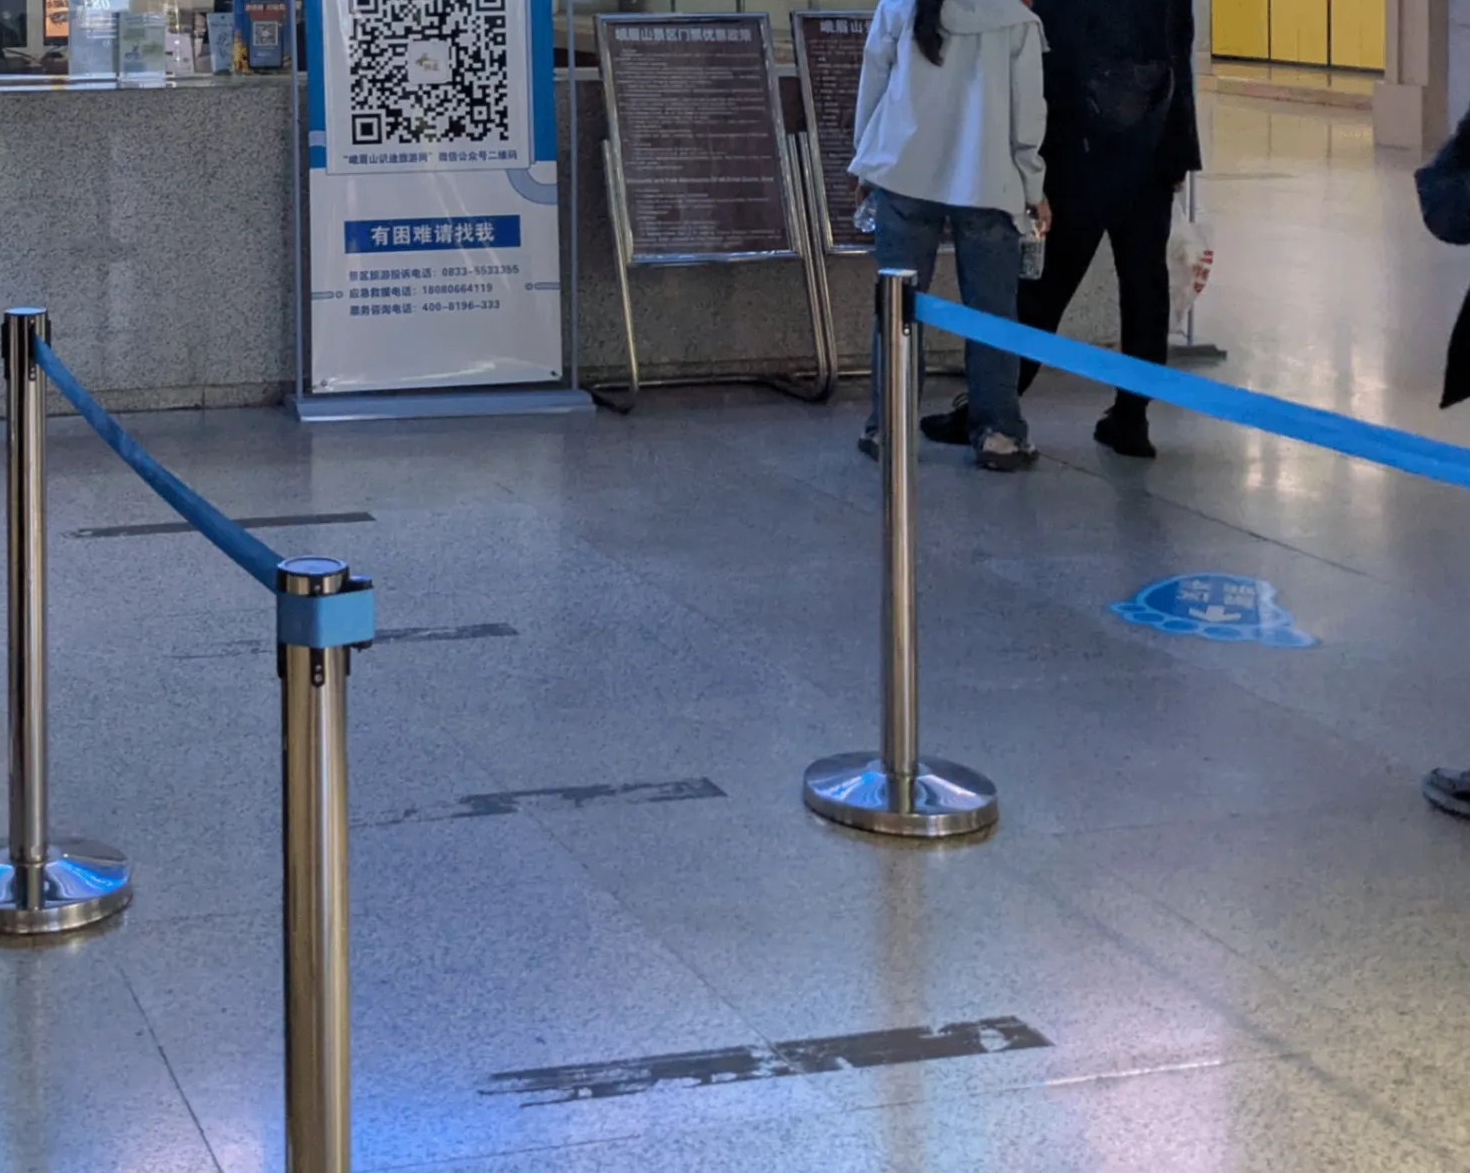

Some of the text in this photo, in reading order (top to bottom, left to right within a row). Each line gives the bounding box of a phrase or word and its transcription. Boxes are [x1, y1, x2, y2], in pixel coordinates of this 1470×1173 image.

[820, 20, 869, 34] 峨眉山
[371, 221, 495, 246] 有困难请找我
